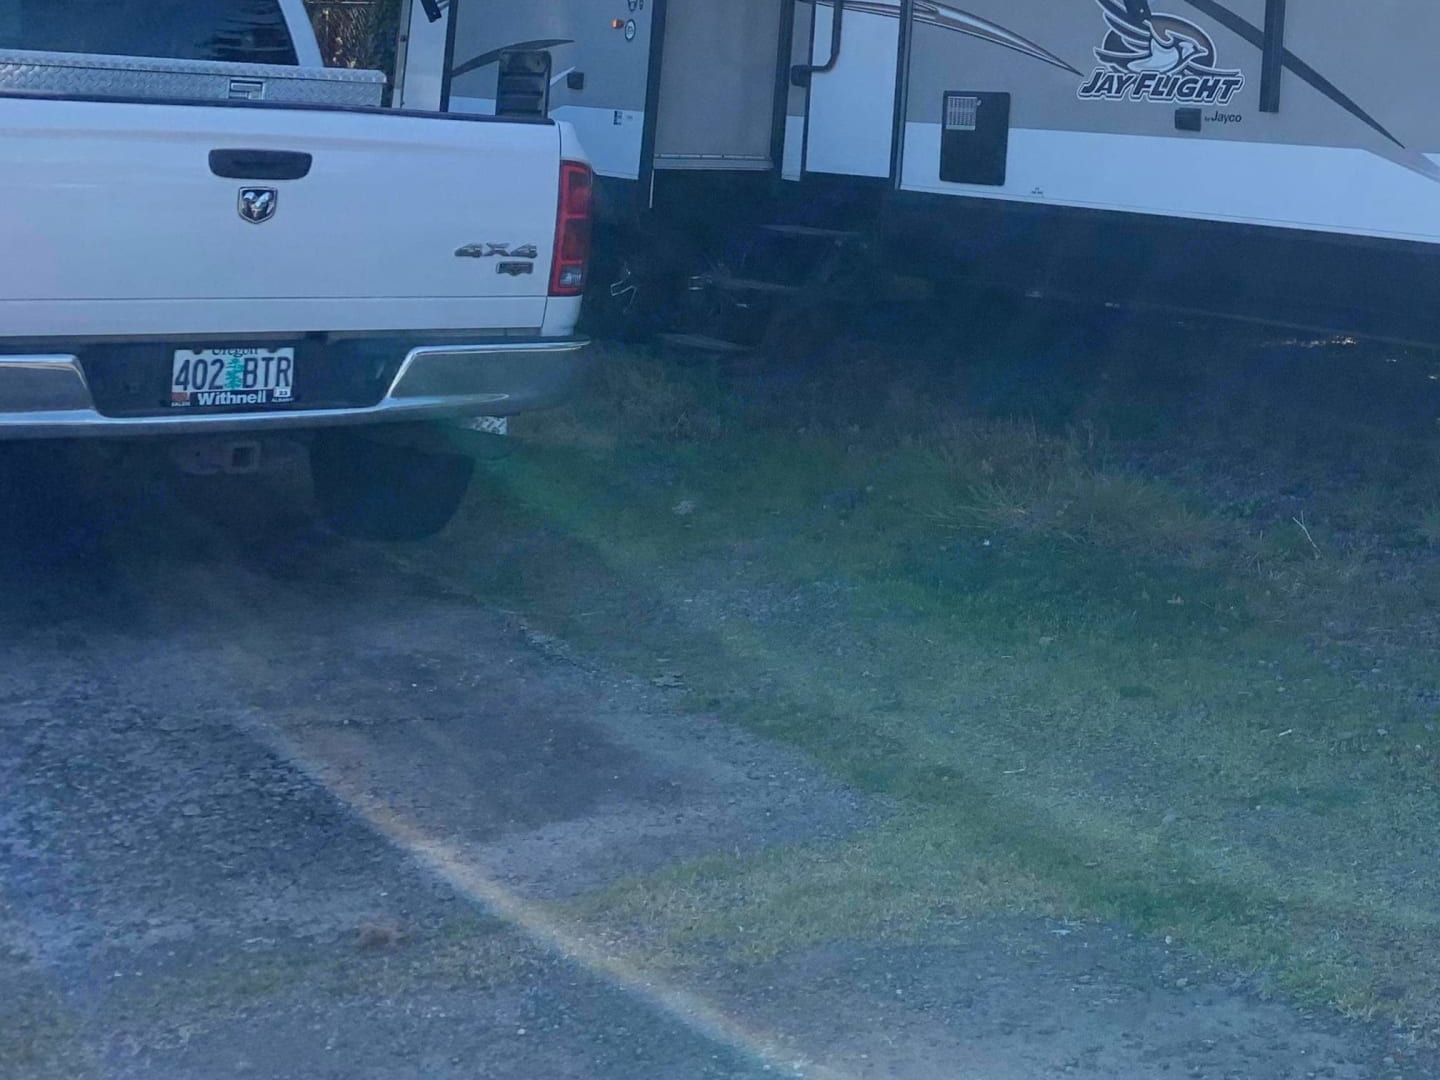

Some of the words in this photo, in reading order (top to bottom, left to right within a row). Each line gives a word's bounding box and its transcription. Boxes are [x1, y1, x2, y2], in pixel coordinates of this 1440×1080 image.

[1079, 69, 1136, 98] JAY
[1131, 72, 1243, 104] FLIGHT
[1211, 110, 1242, 124] Jayco
[174, 358, 225, 391] 402
[242, 356, 291, 388] BTR
[198, 390, 266, 406] Withnell
